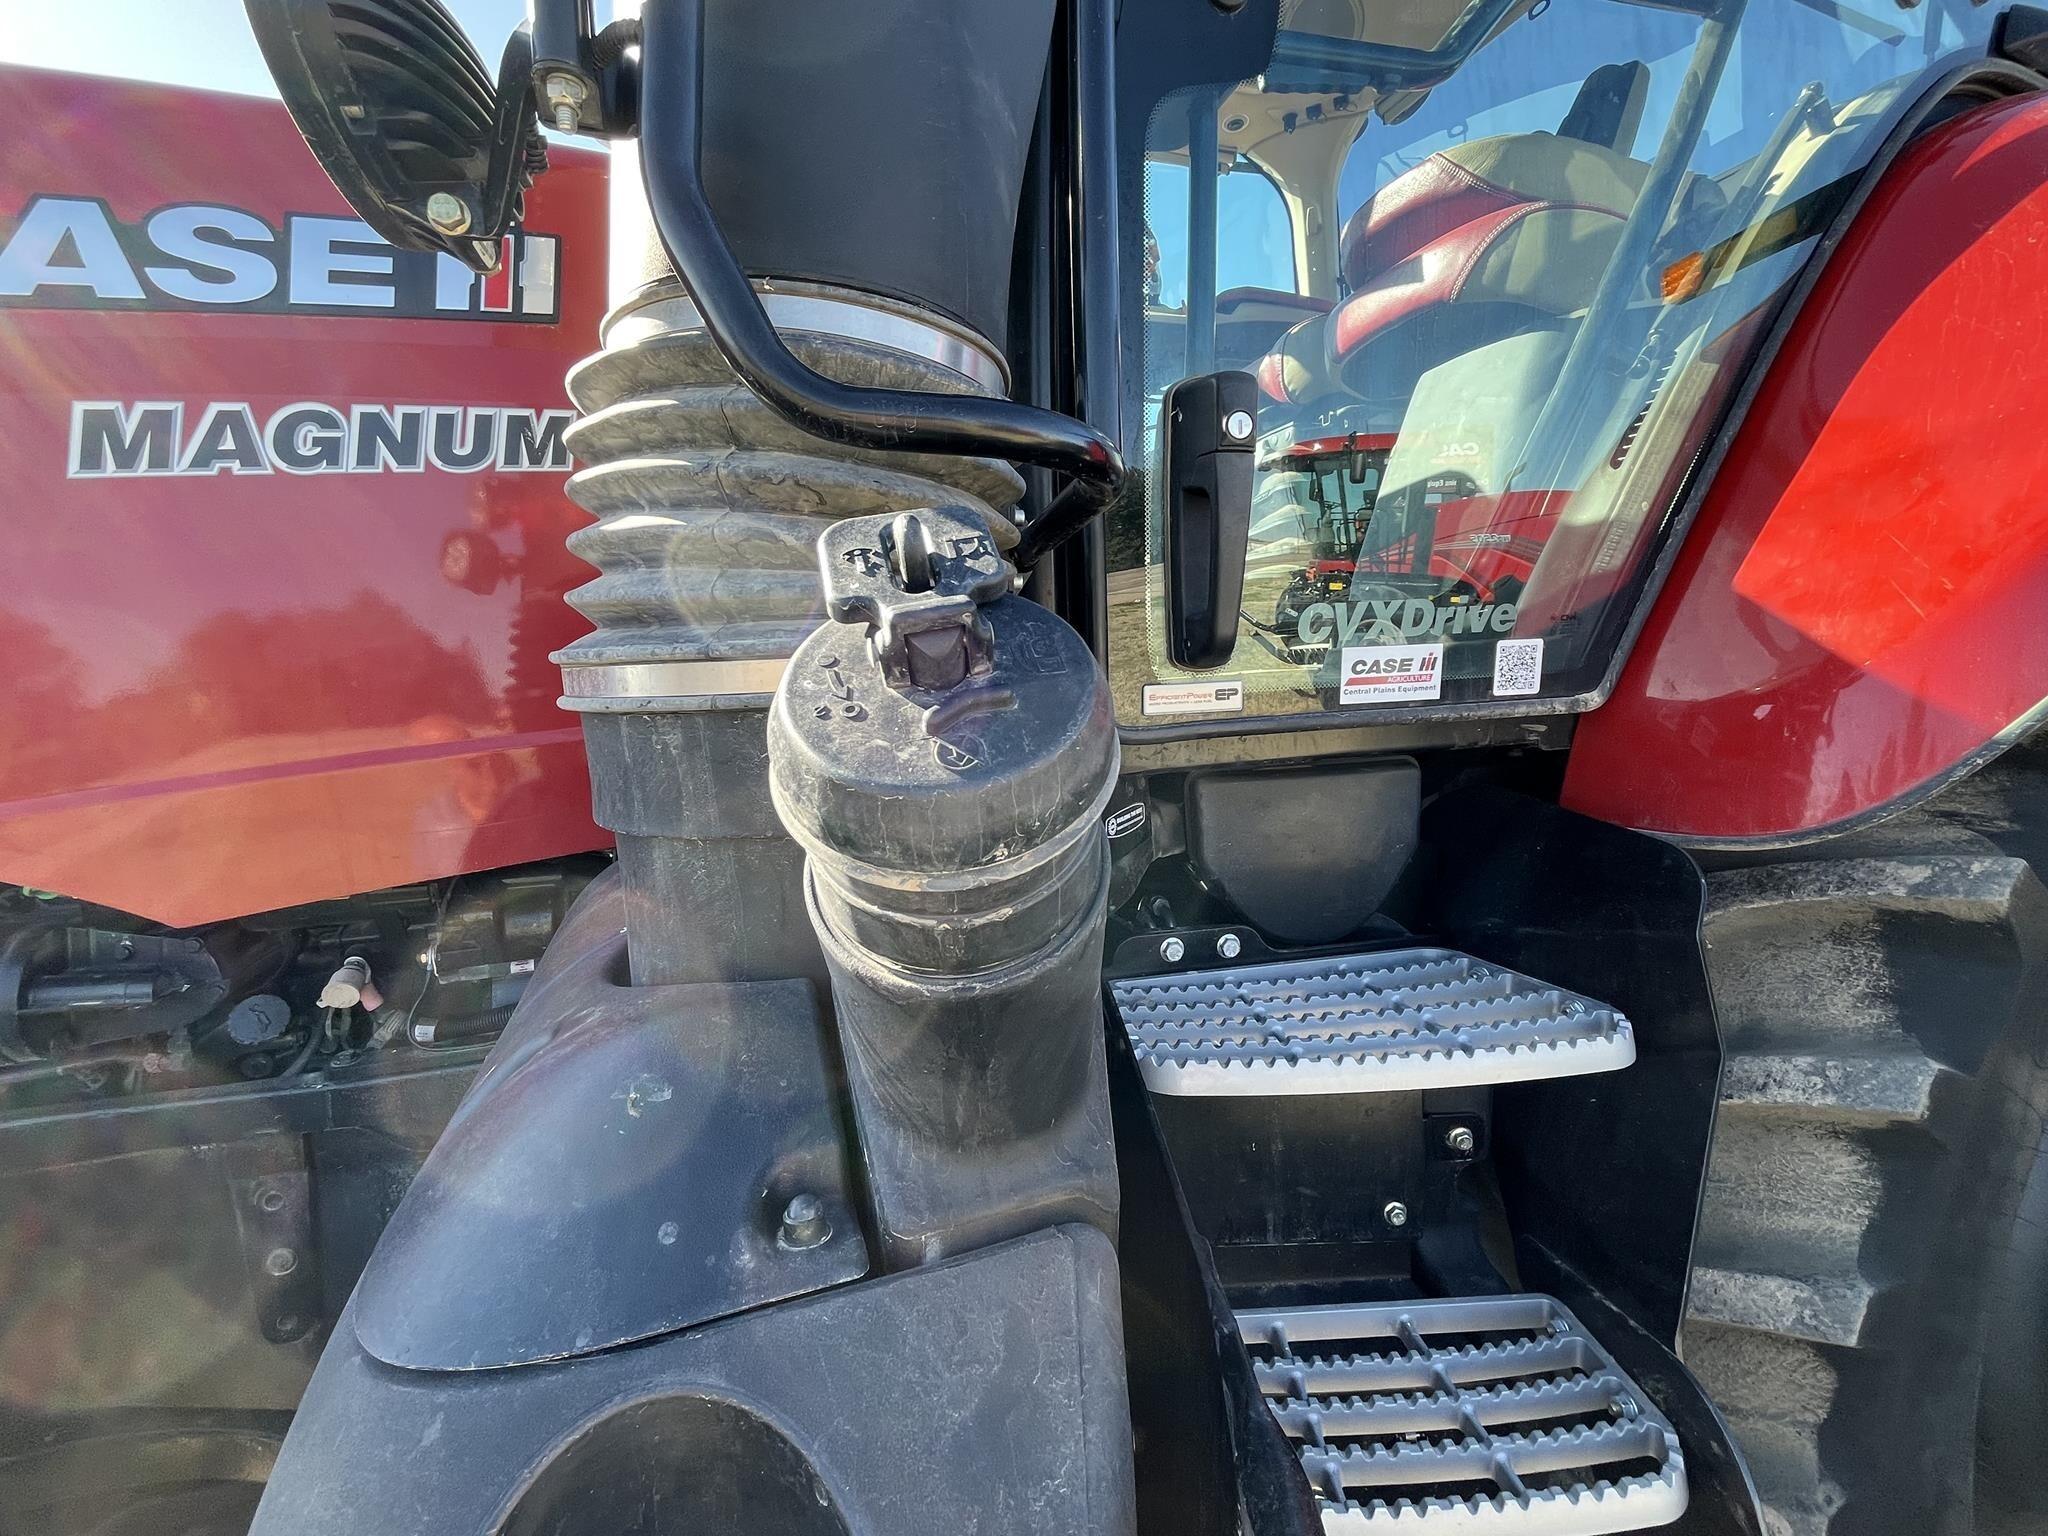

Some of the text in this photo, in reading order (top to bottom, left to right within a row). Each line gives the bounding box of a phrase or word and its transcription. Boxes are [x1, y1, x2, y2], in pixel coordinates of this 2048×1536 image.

[67, 401, 577, 478] MAGNUM
[1298, 595, 1518, 644] CVXDrive
[1351, 657, 1415, 676] CASE
[1387, 674, 1432, 683] AGRICULTURE
[1214, 687, 1239, 701] EP
[1343, 685, 1436, 696] Central Plains Equipment
